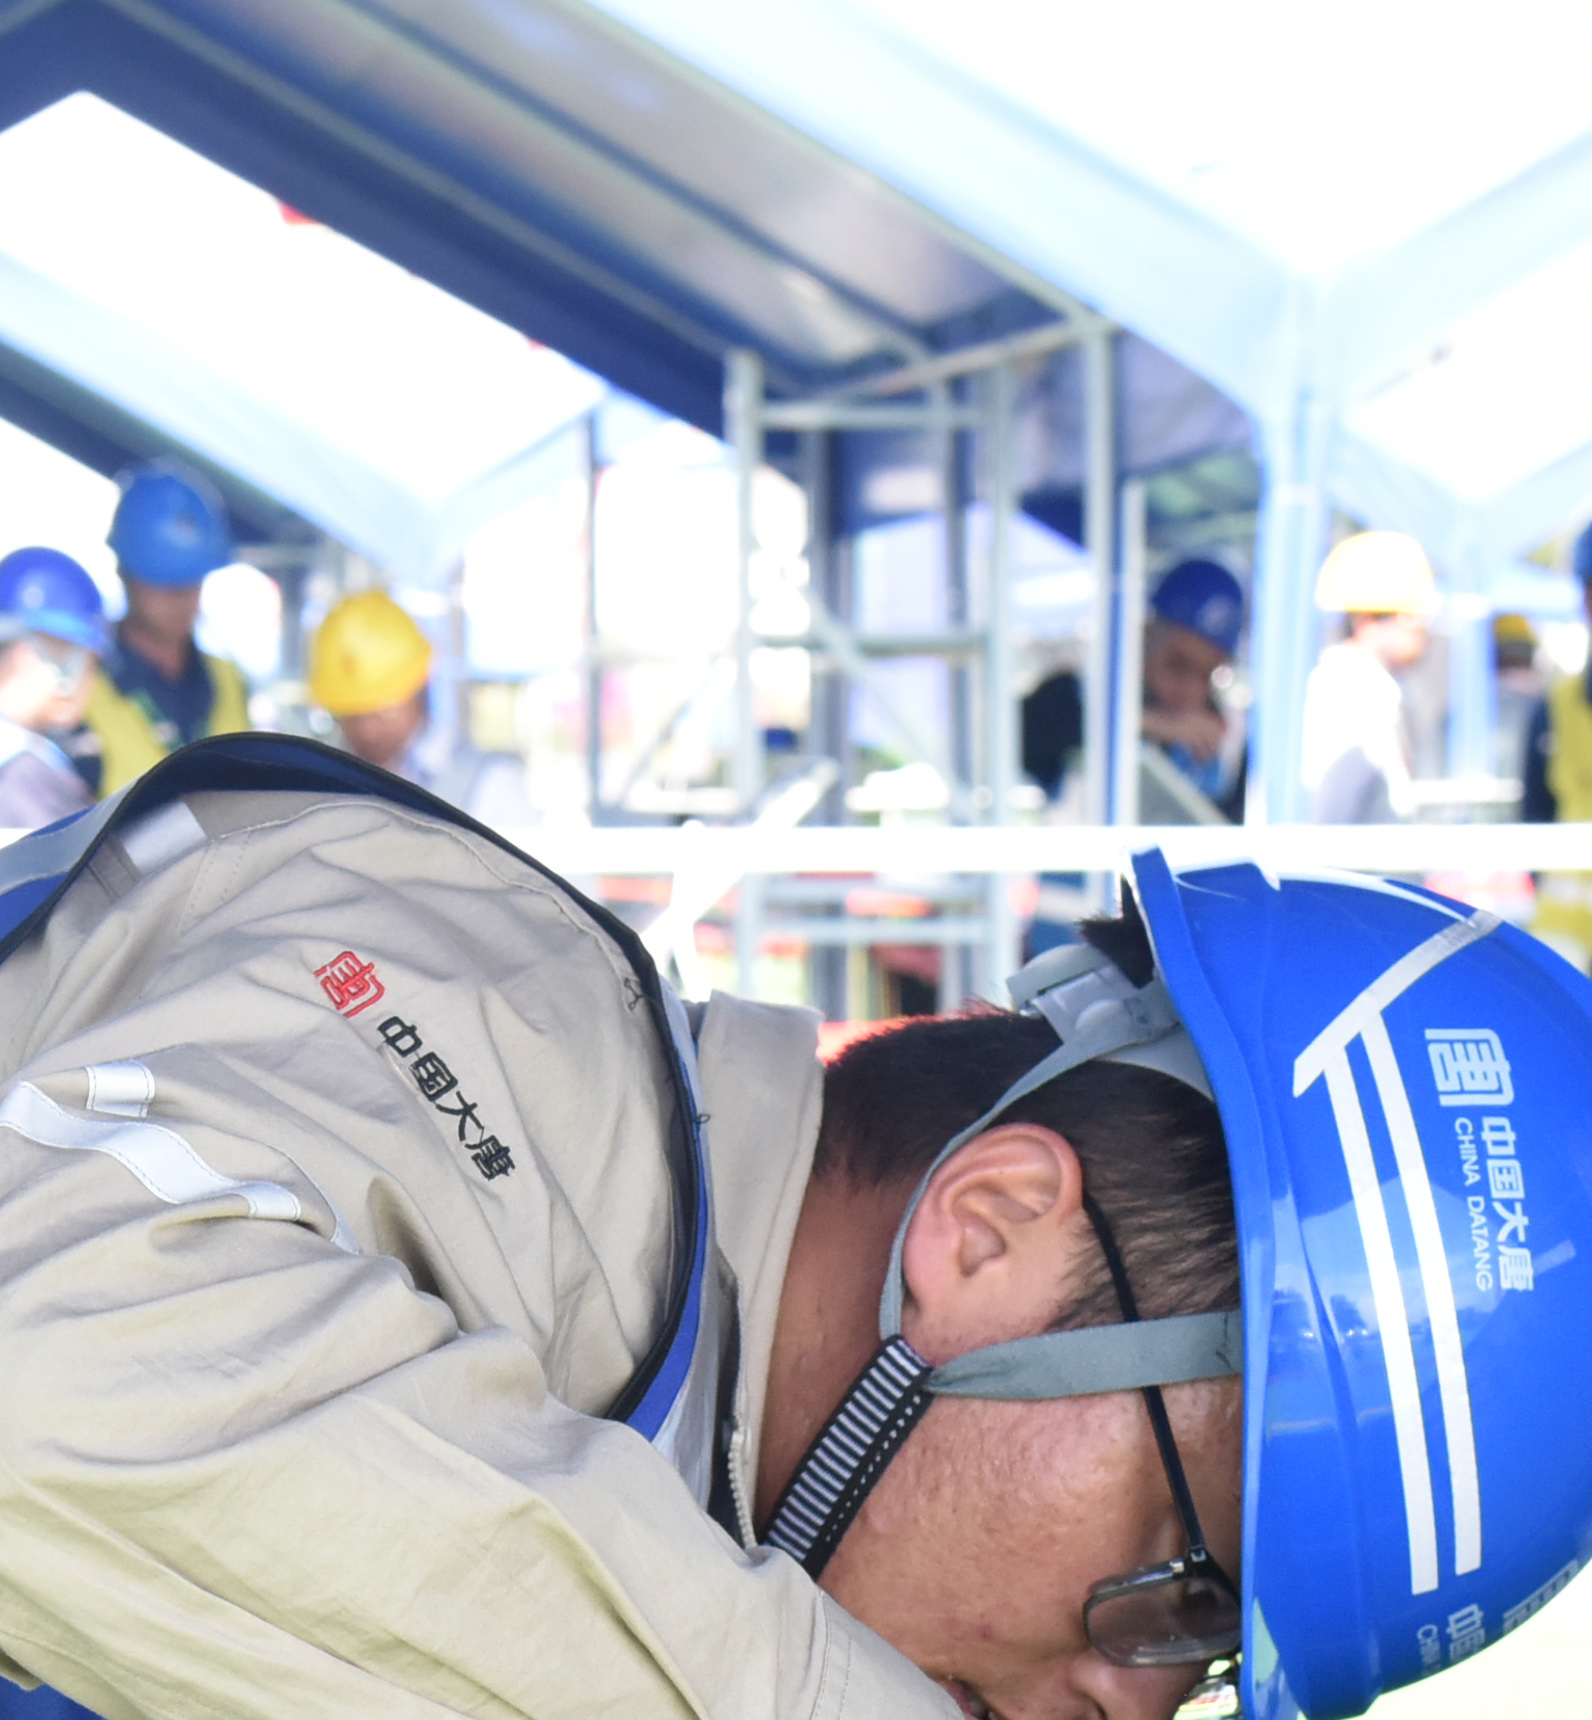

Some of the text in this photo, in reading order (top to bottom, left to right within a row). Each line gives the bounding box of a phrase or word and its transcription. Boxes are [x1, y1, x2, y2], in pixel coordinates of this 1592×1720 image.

[1454, 1117, 1493, 1291] CHINA DATANG
[1481, 1116, 1534, 1291] 中国大唐
